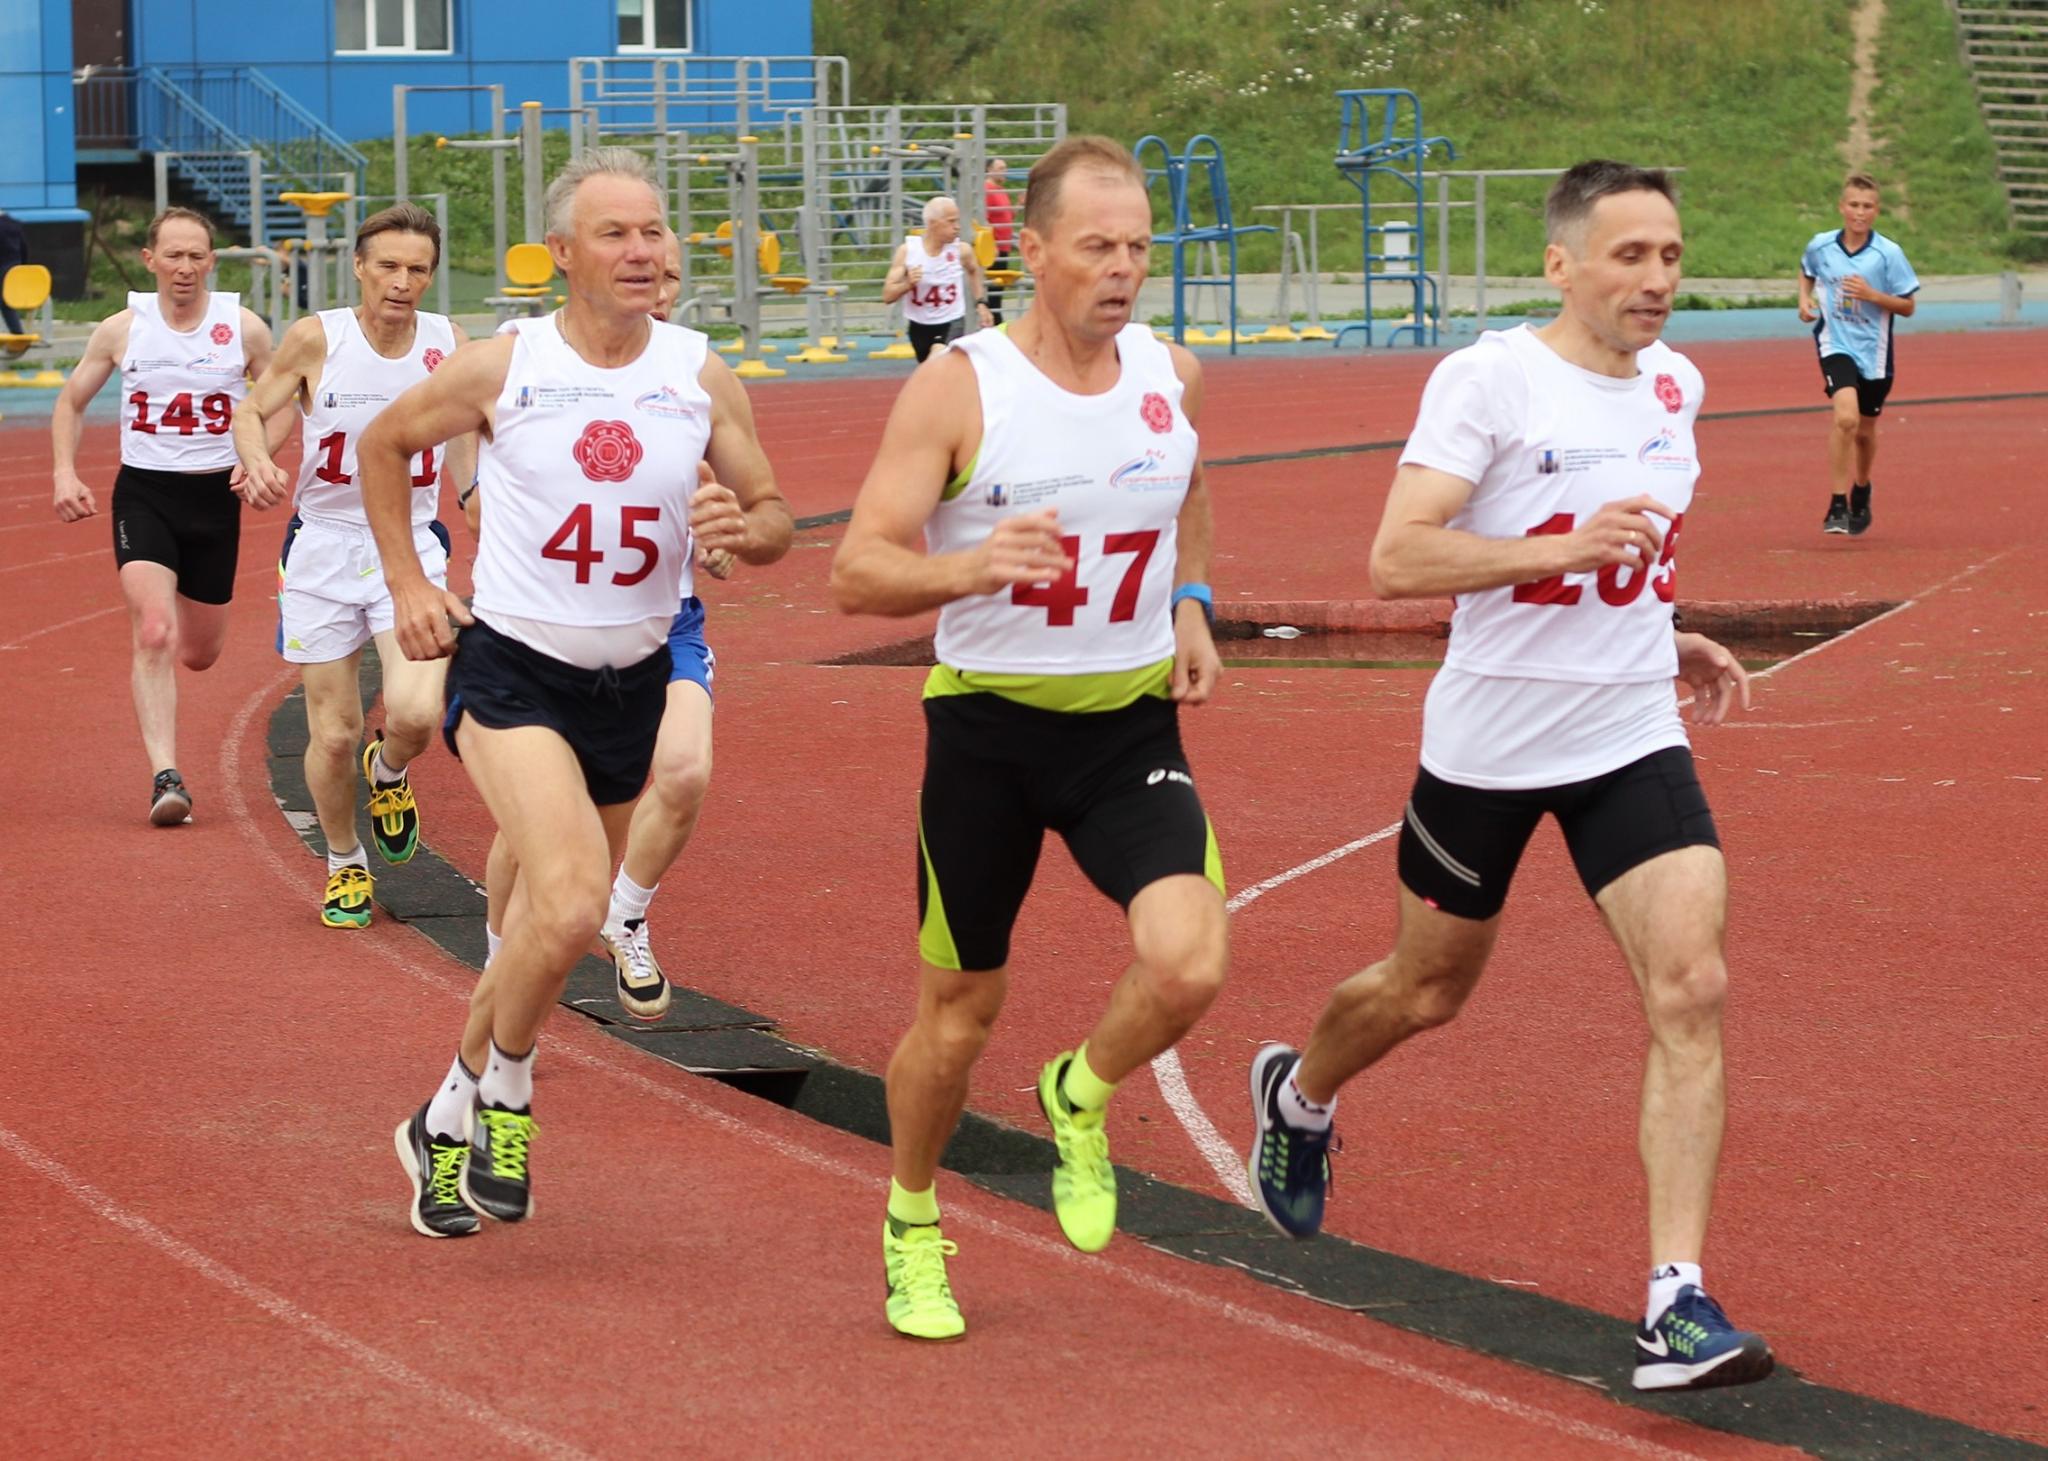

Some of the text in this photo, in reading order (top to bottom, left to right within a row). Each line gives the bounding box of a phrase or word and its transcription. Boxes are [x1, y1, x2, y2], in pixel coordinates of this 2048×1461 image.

[911, 283, 957, 307] 143
[129, 391, 232, 436] 149
[316, 431, 437, 488] 11
[541, 503, 660, 587] 45
[1012, 528, 1160, 627] 47
